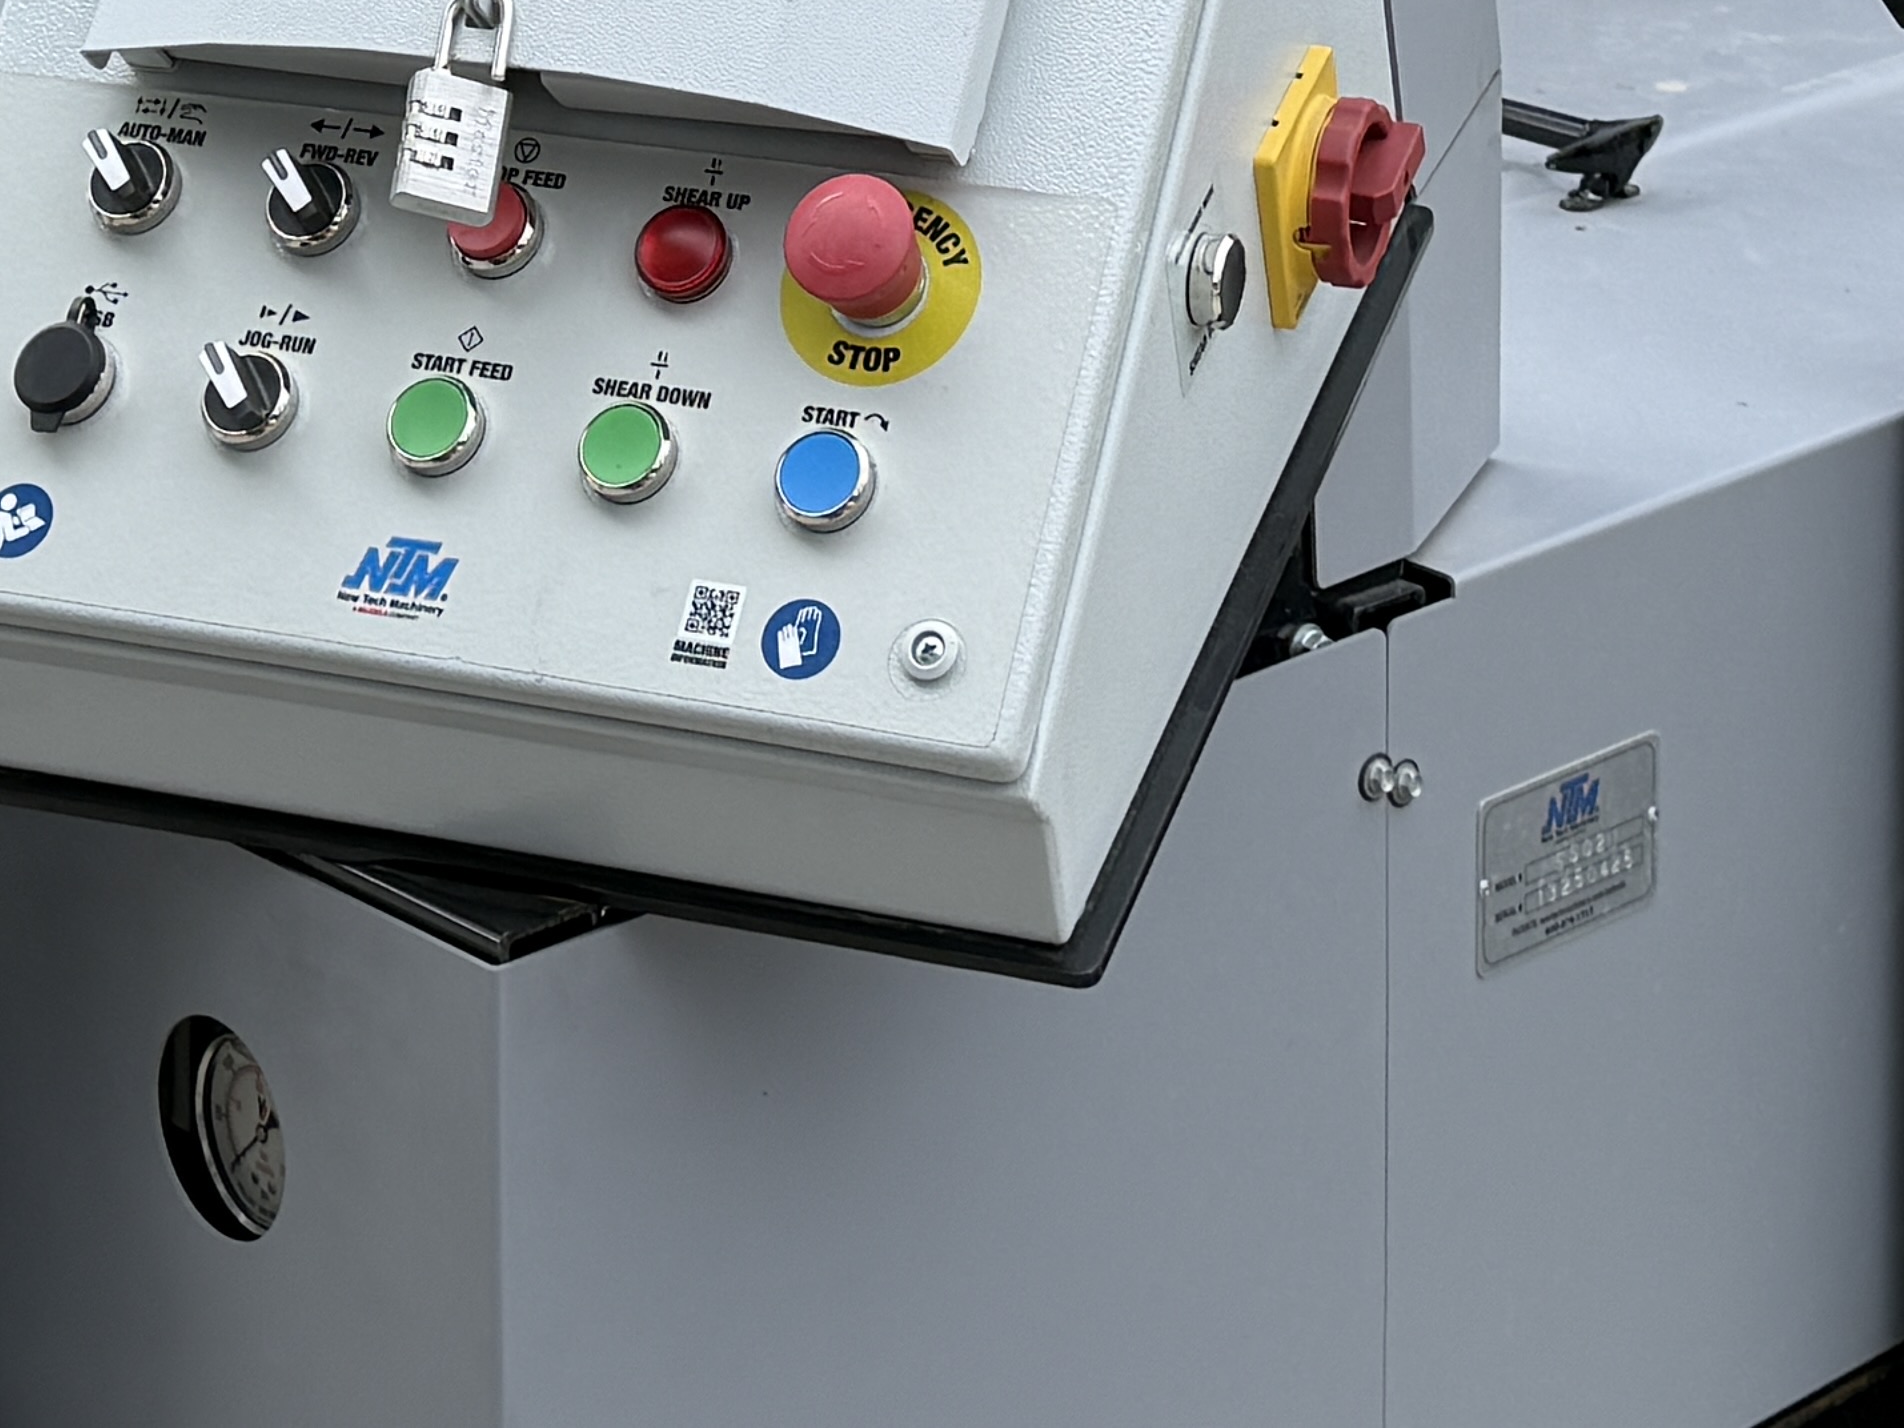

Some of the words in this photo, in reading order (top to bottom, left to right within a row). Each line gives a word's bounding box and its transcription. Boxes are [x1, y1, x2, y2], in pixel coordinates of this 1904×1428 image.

[118, 121, 207, 146] AUTO-MAN
[299, 143, 380, 166] FWD-REV
[522, 169, 567, 189] FEED
[662, 185, 722, 209] SHEAR
[726, 193, 751, 211] UP
[238, 329, 317, 355] JOG-RUN
[411, 352, 466, 375] START
[468, 361, 514, 381] FEED
[827, 340, 901, 373] STOP
[592, 377, 652, 400] SHEAR
[655, 385, 712, 410] DOWN
[801, 405, 861, 429] START
[341, 536, 459, 601] NTM
